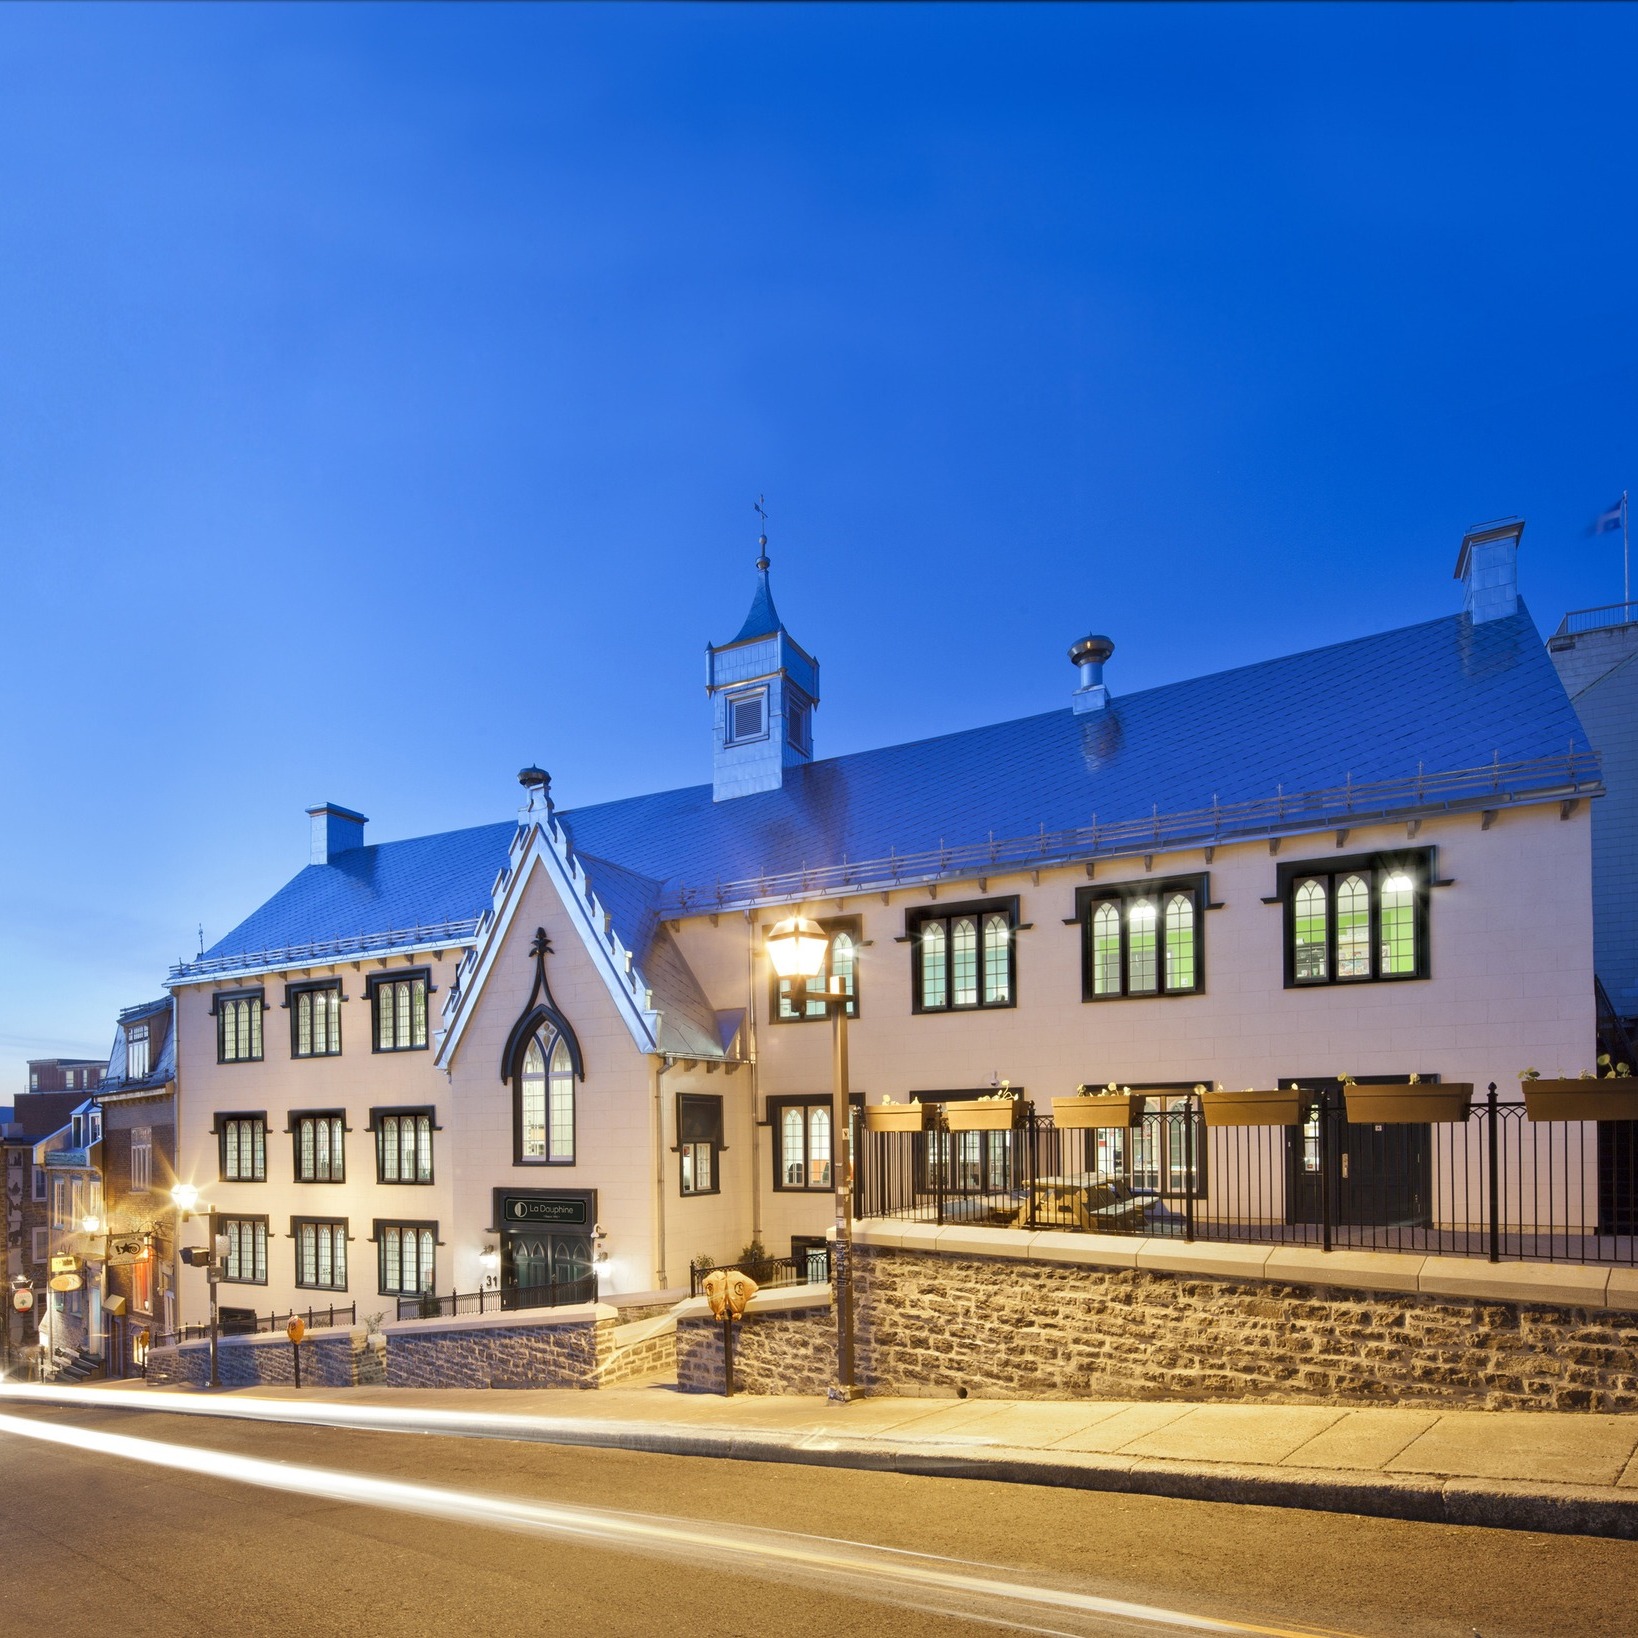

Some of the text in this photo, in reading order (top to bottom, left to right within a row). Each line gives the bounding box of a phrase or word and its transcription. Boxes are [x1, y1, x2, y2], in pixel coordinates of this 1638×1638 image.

[529, 1204, 574, 1214] La Dauphine
[486, 1275, 498, 1287] 31
